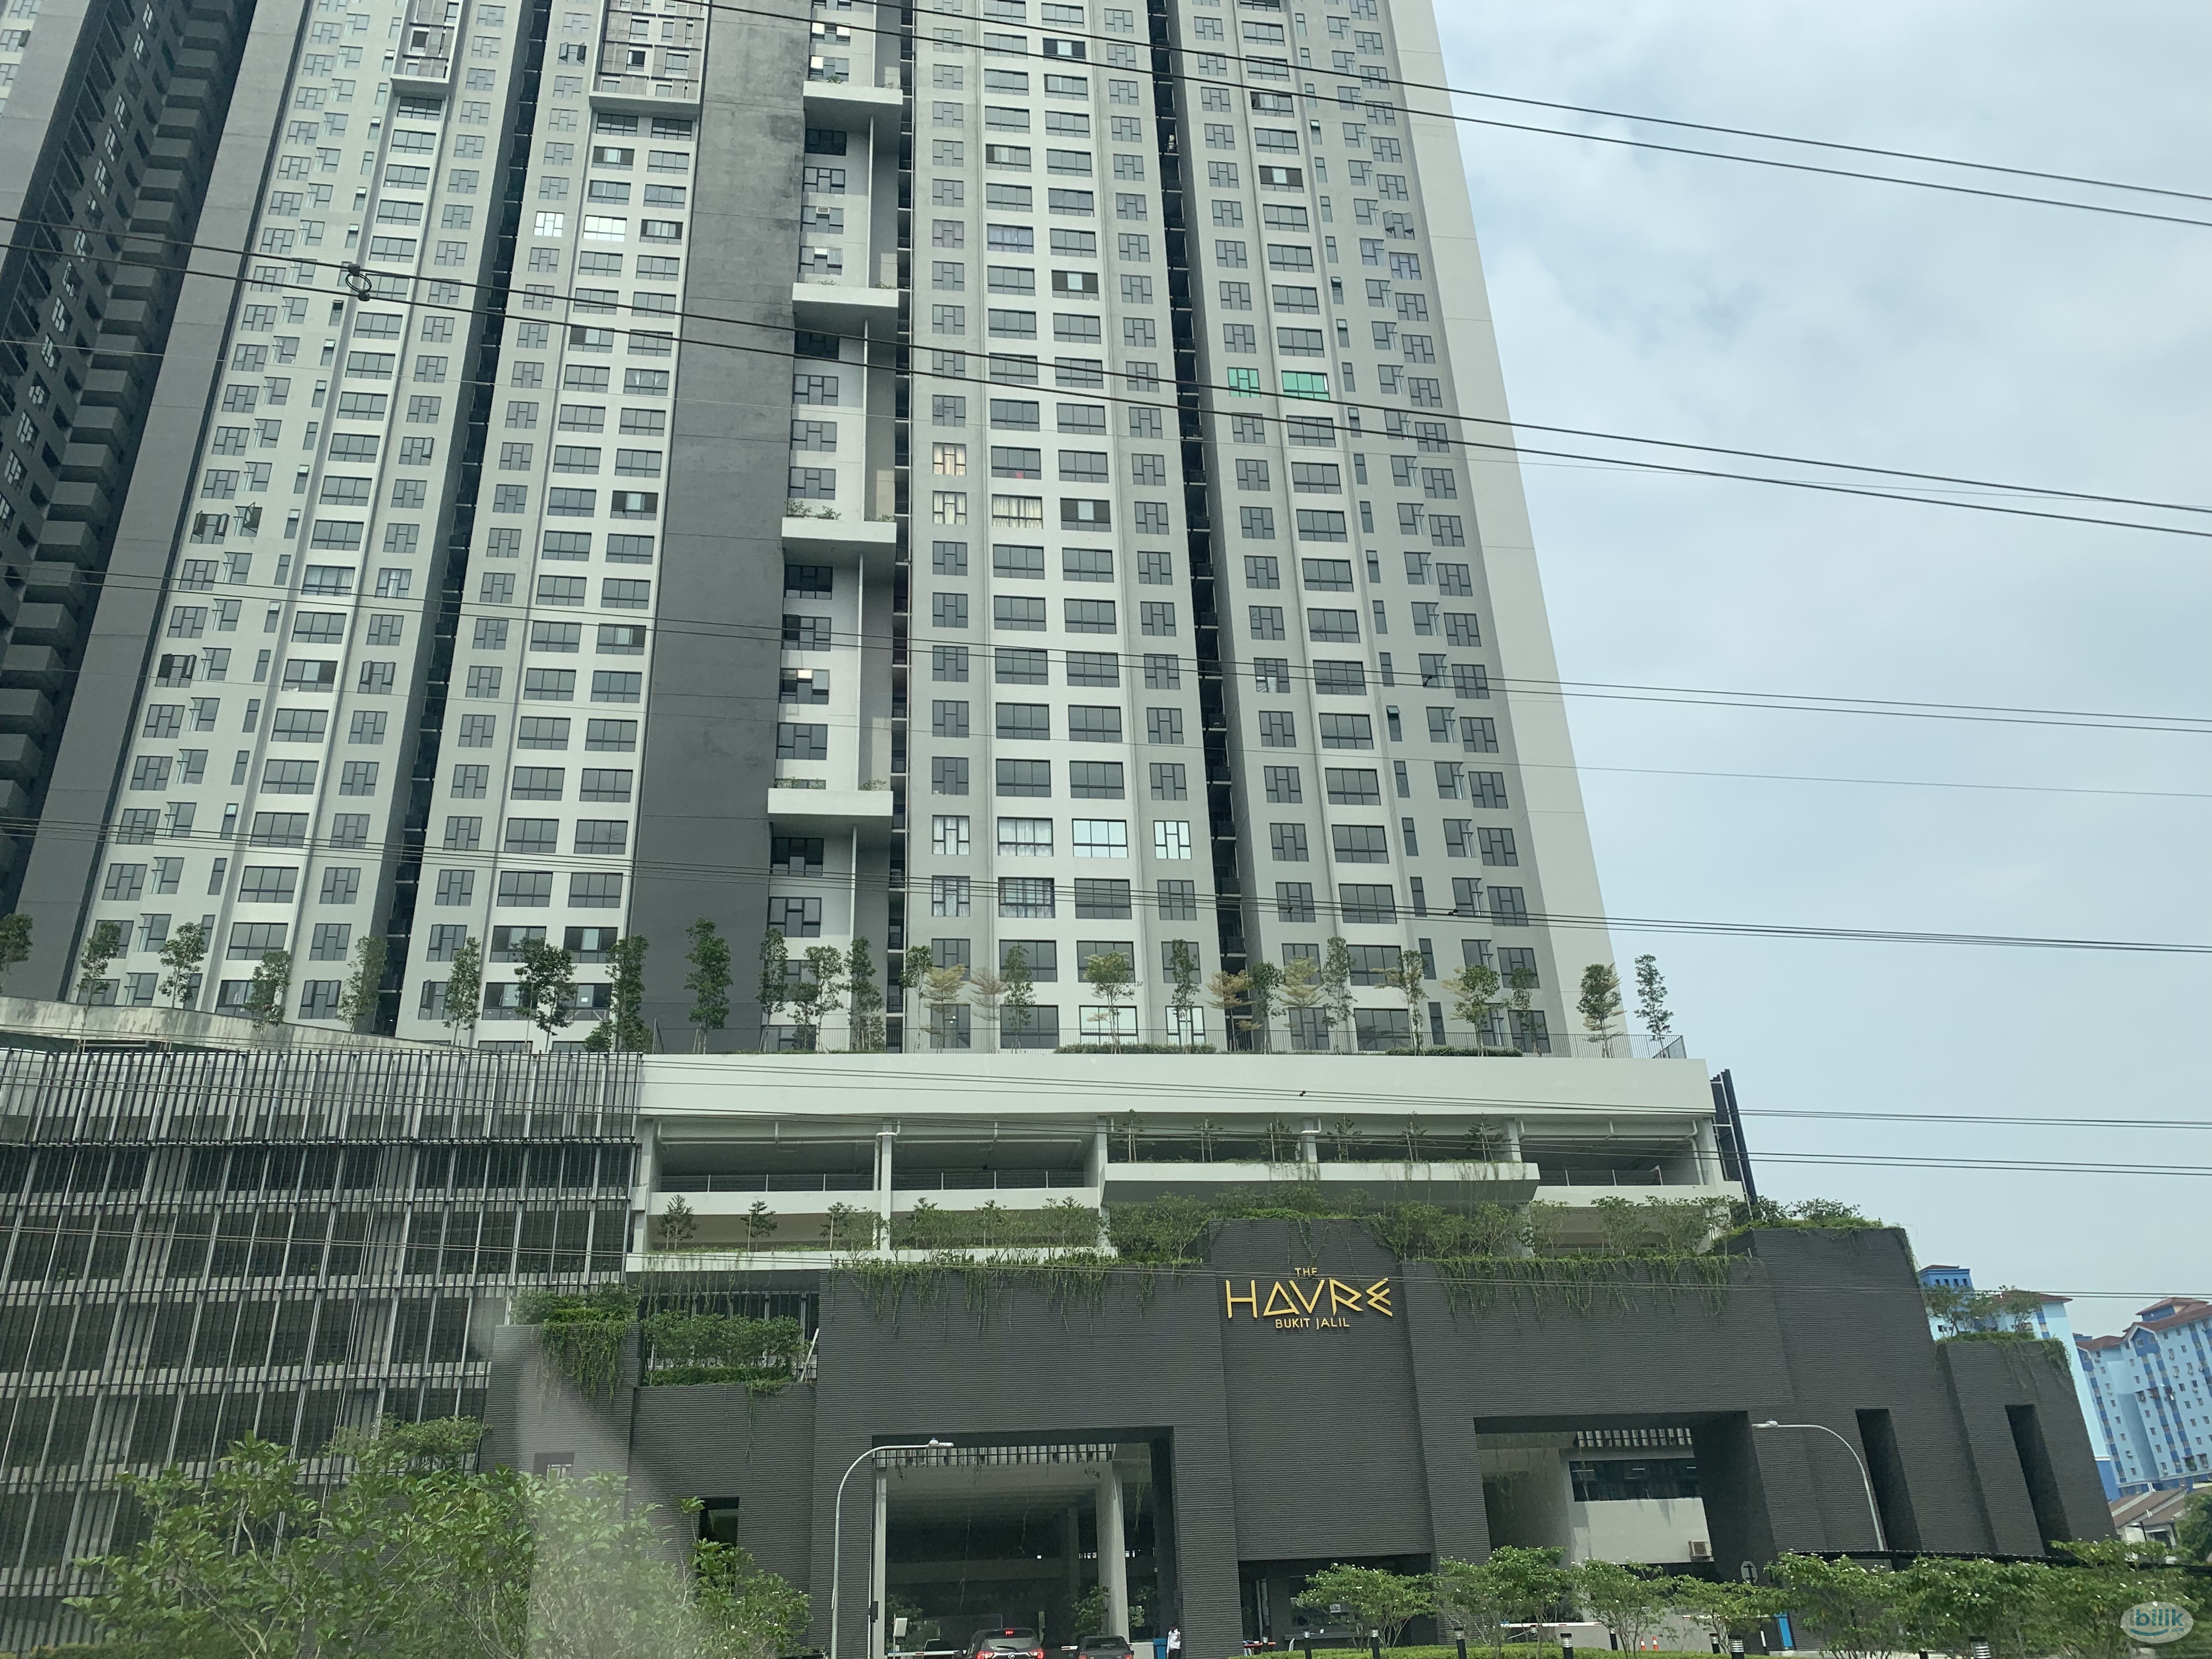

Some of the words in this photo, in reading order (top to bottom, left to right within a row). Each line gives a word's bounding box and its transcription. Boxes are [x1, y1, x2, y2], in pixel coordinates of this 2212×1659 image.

[1294, 1267, 1318, 1277] THE
[1226, 1278, 1393, 1318] HAVRE
[1275, 1318, 1311, 1329] BUKIT
[1316, 1317, 1350, 1330] JALIL
